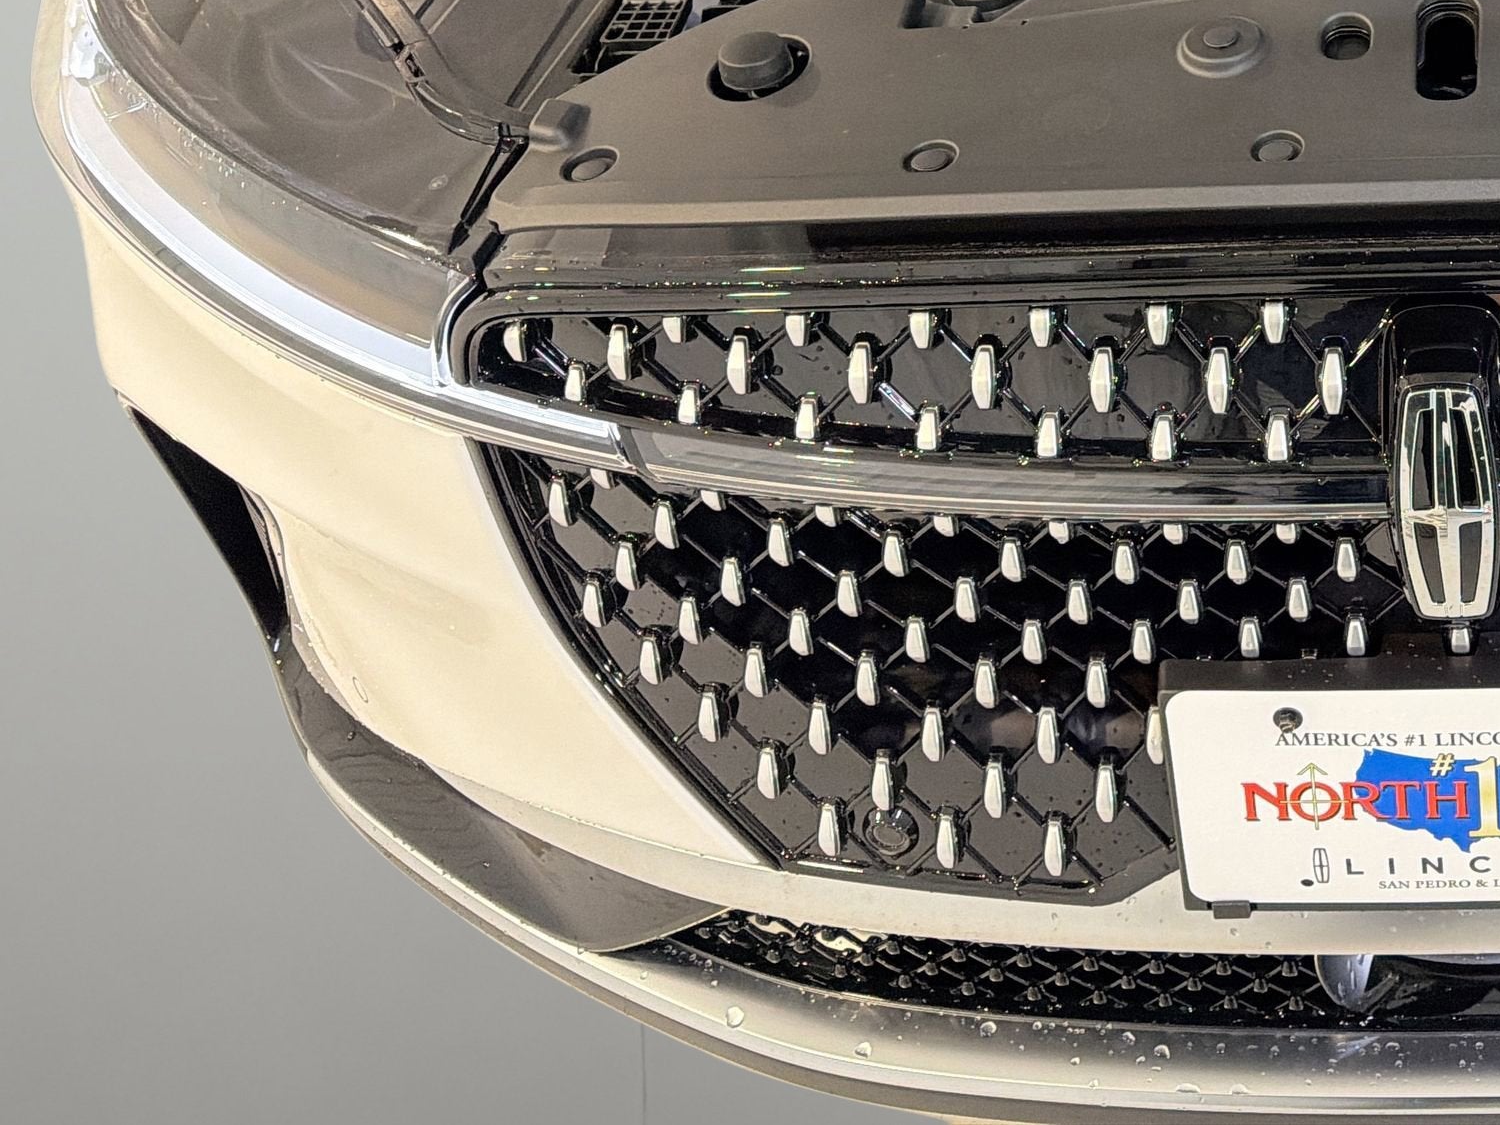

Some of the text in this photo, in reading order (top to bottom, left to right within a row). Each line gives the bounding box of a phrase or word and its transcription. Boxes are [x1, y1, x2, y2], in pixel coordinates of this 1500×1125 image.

[1274, 731, 1398, 747] AMERICA'S
[1404, 733, 1427, 747] #1
[1240, 779, 1469, 823] NORTH
[1378, 879, 1410, 890] SAN
[1415, 879, 1471, 889] PEDRO
[1475, 879, 1489, 888] &
